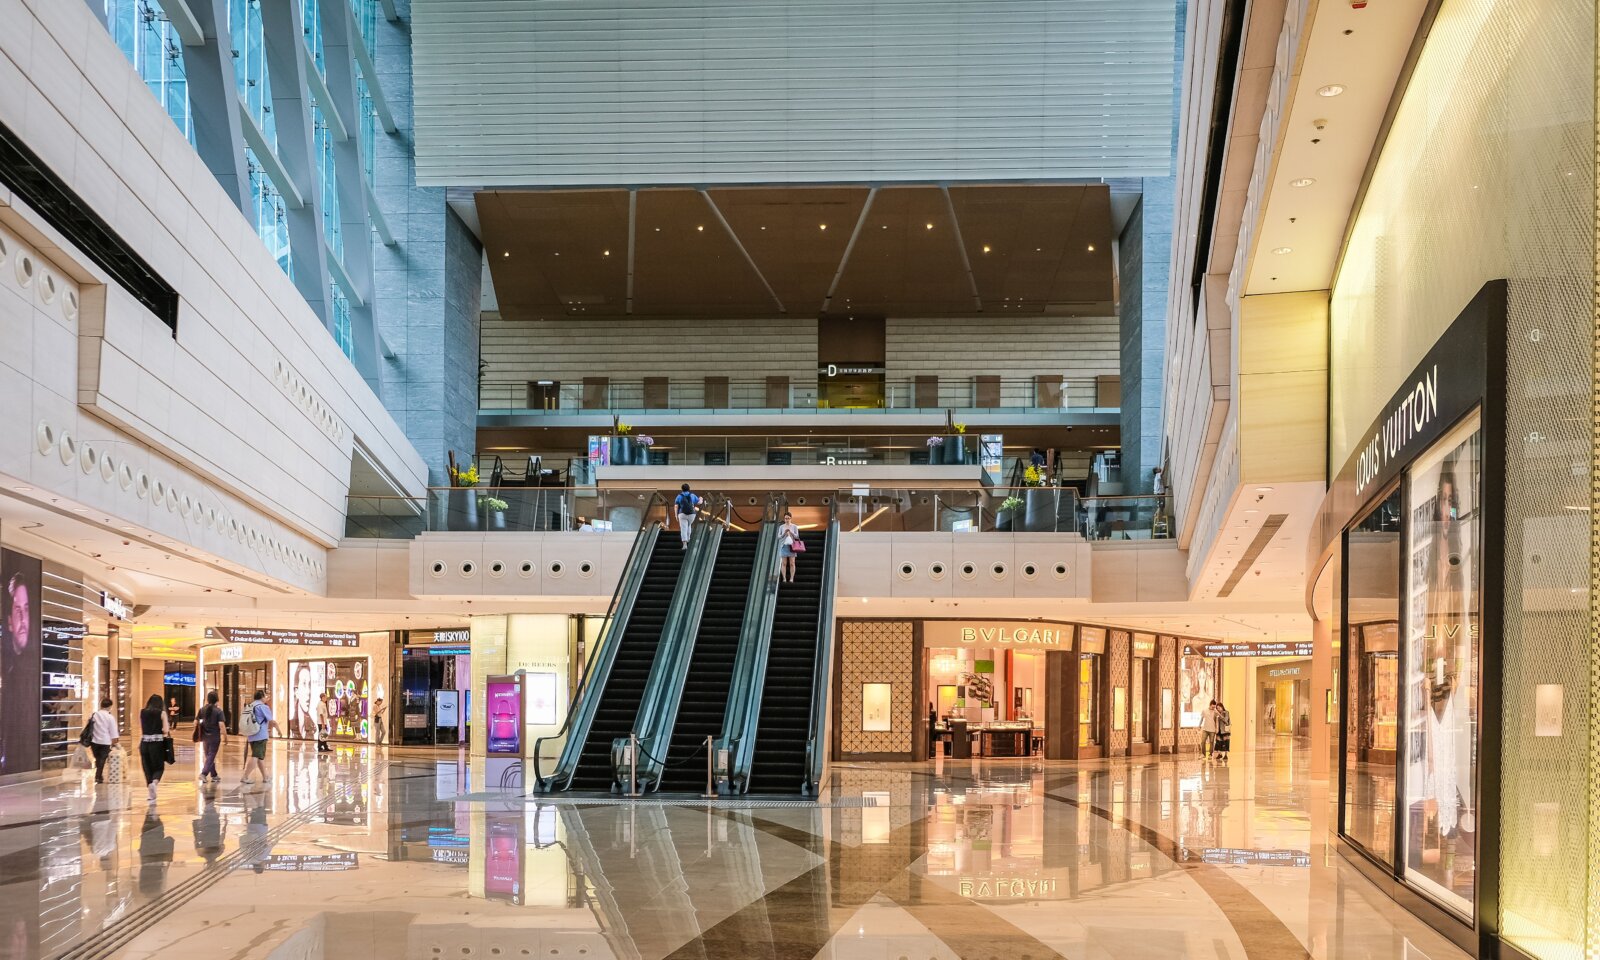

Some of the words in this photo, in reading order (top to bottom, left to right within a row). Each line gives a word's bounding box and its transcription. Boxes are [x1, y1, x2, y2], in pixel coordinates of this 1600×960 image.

[828, 364, 837, 377] D
[1356, 433, 1379, 496] LOUIS
[1383, 364, 1437, 467] VUITTON
[961, 627, 1060, 645] BVLGARI
